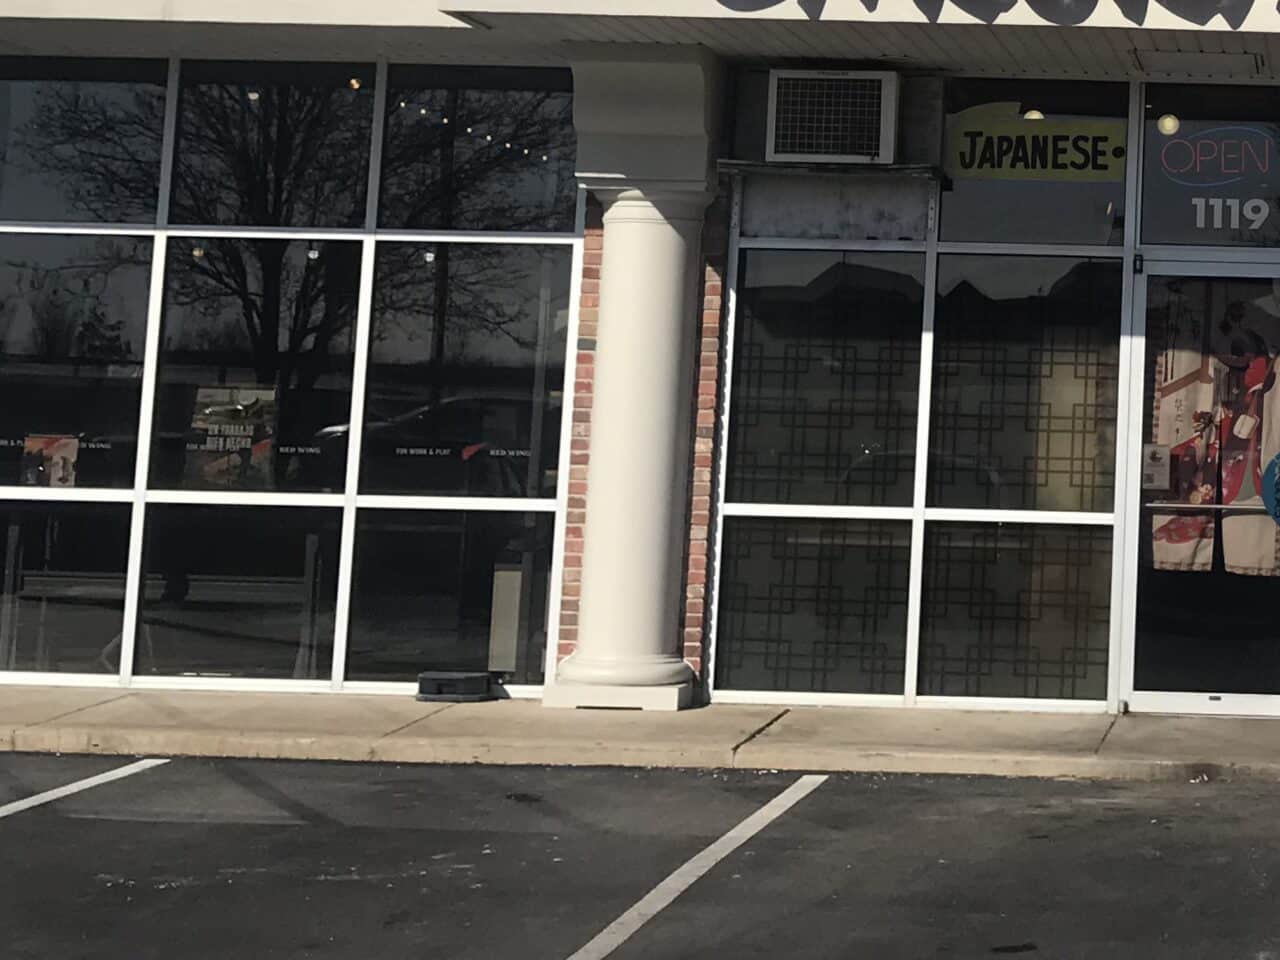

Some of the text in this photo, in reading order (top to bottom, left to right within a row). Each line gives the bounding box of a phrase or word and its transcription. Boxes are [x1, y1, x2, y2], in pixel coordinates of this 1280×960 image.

[959, 131, 1109, 171] JAPANESE
[1161, 139, 1271, 174] OPEN
[1191, 197, 1270, 230] 1119
